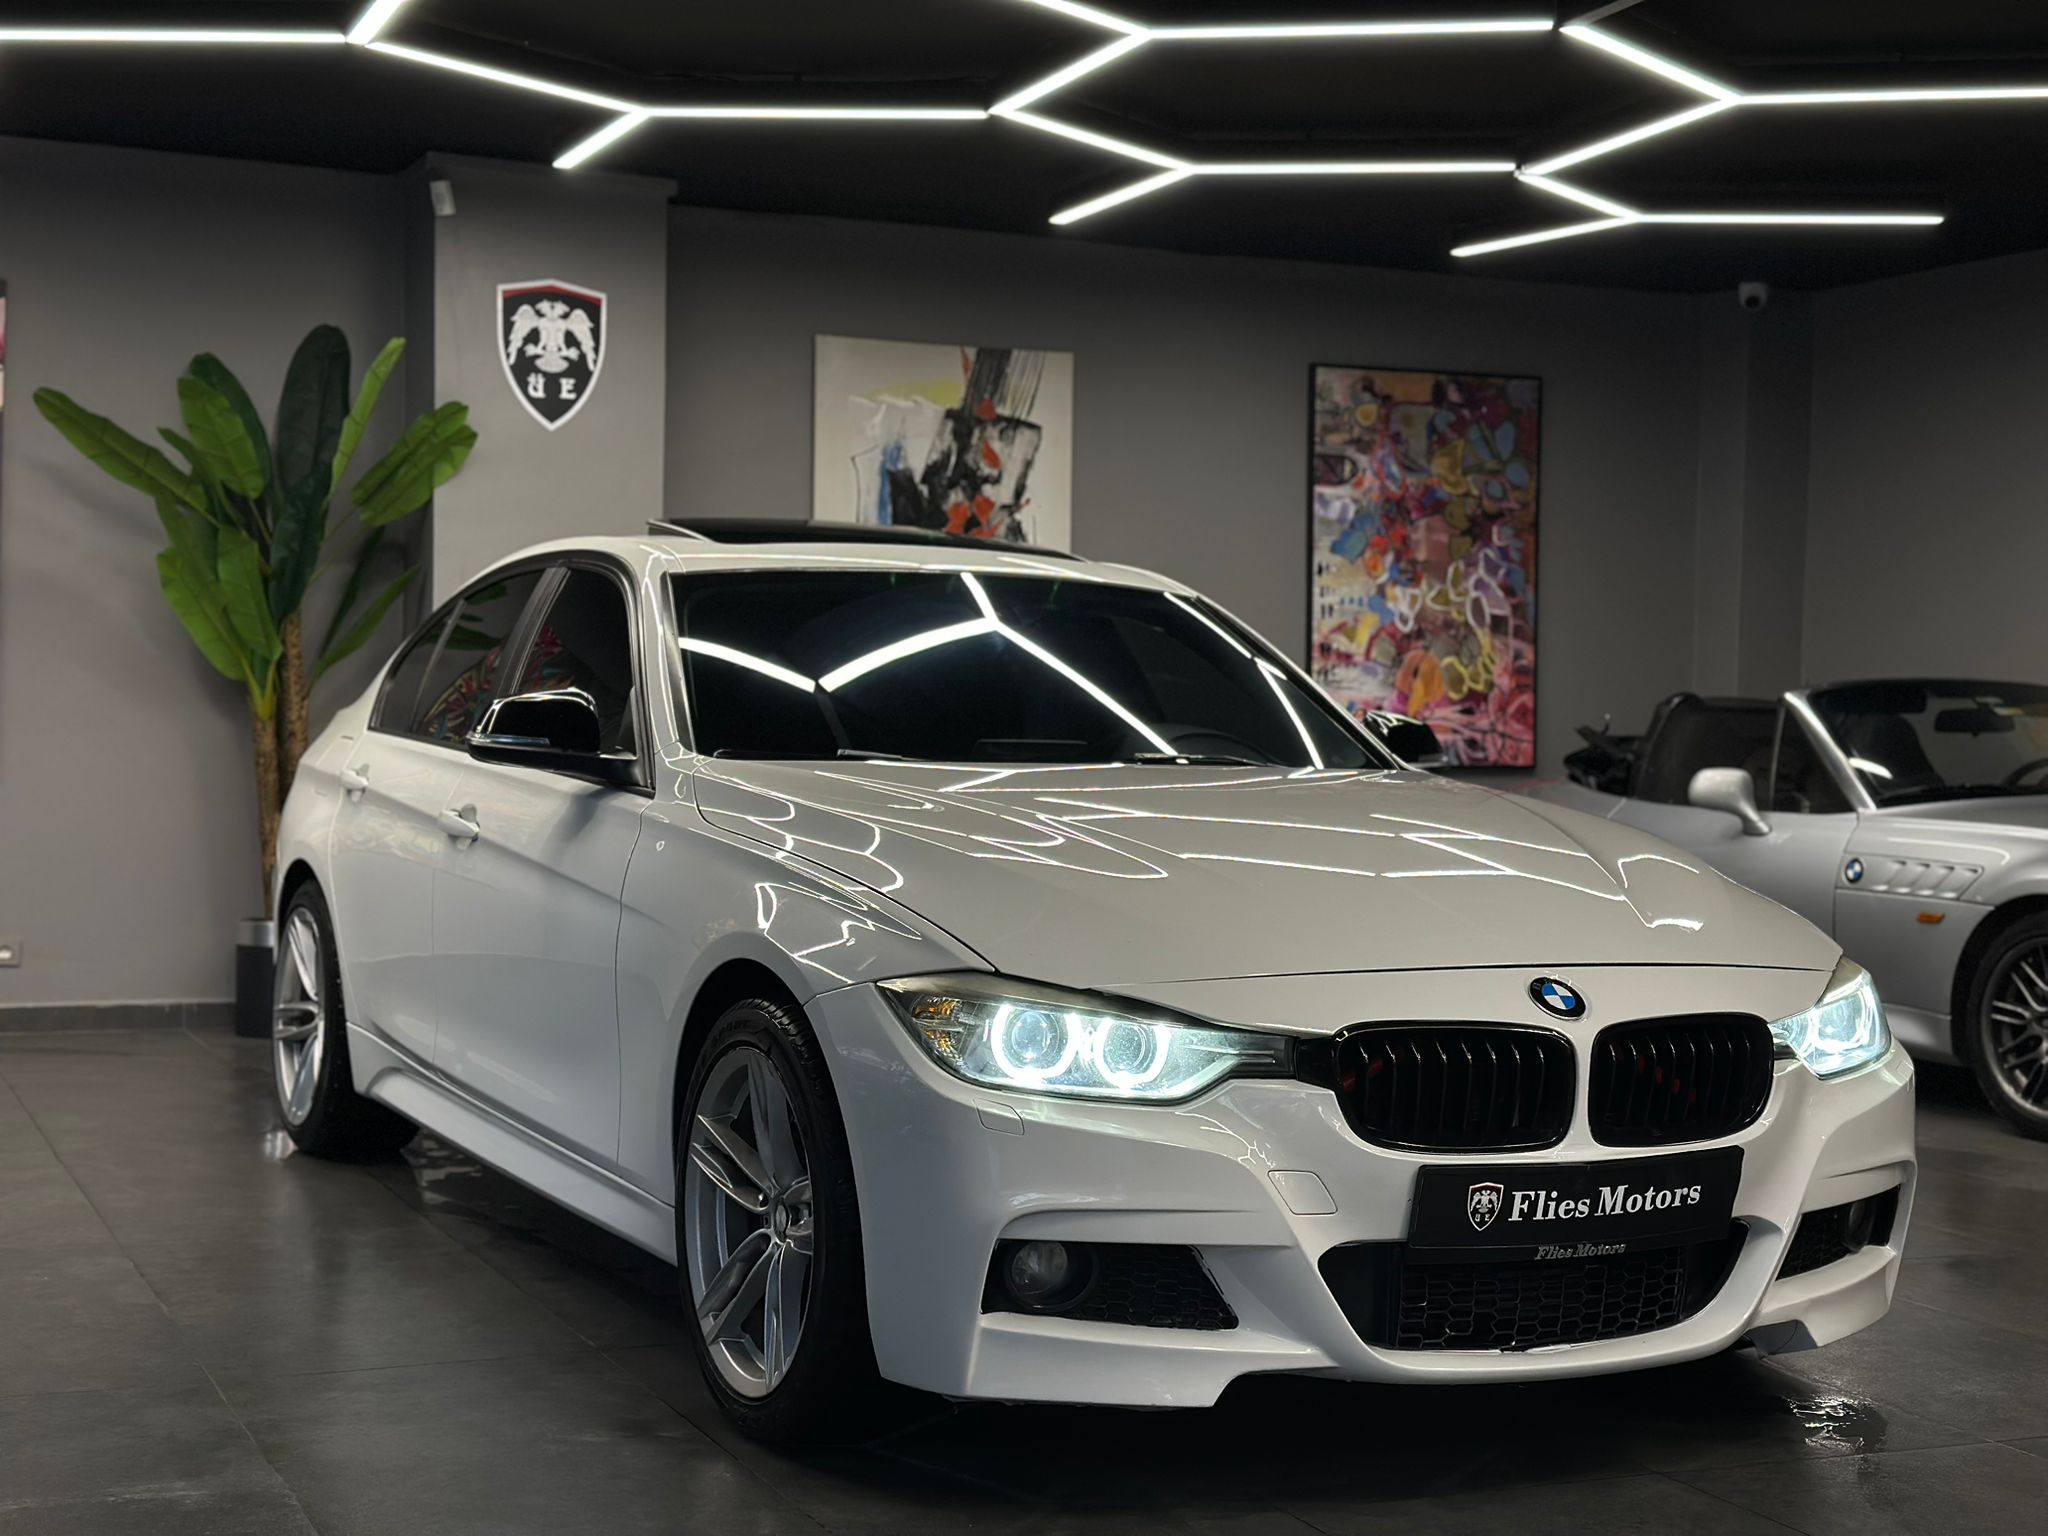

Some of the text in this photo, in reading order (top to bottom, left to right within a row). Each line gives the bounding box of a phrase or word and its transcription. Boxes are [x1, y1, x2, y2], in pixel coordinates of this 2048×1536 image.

[1507, 1184, 1702, 1222] Flies Motors
[1534, 1243, 1627, 1261] Flies Motors
